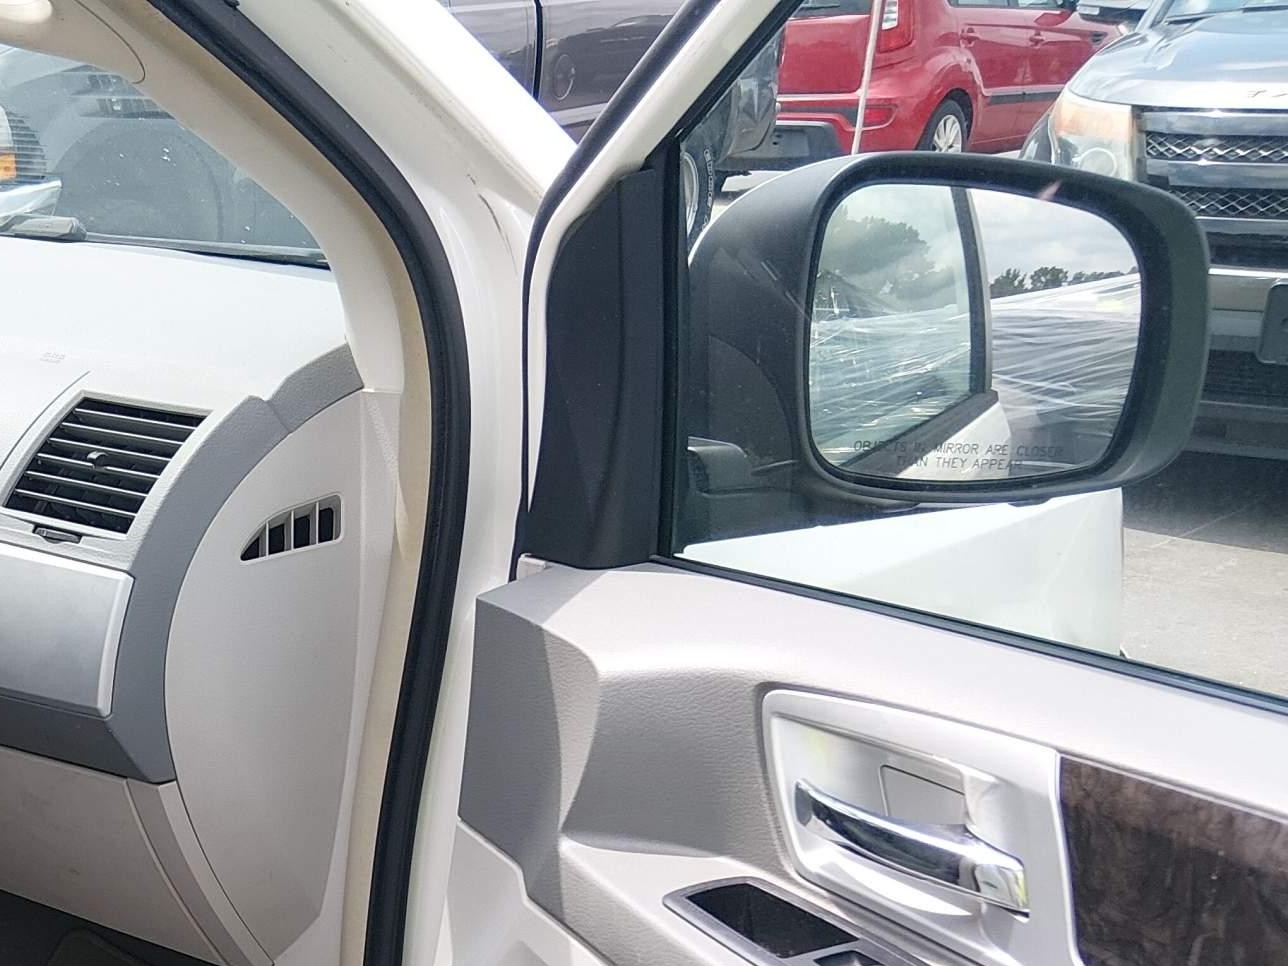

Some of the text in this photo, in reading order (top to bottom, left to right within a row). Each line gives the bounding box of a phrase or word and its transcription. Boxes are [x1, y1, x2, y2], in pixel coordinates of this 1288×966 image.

[935, 443, 980, 455] MIRROR
[985, 444, 1009, 456] ARE
[1016, 445, 1065, 457] CLOSER
[935, 456, 967, 469] THEY
[972, 458, 1023, 471] APPEAR
